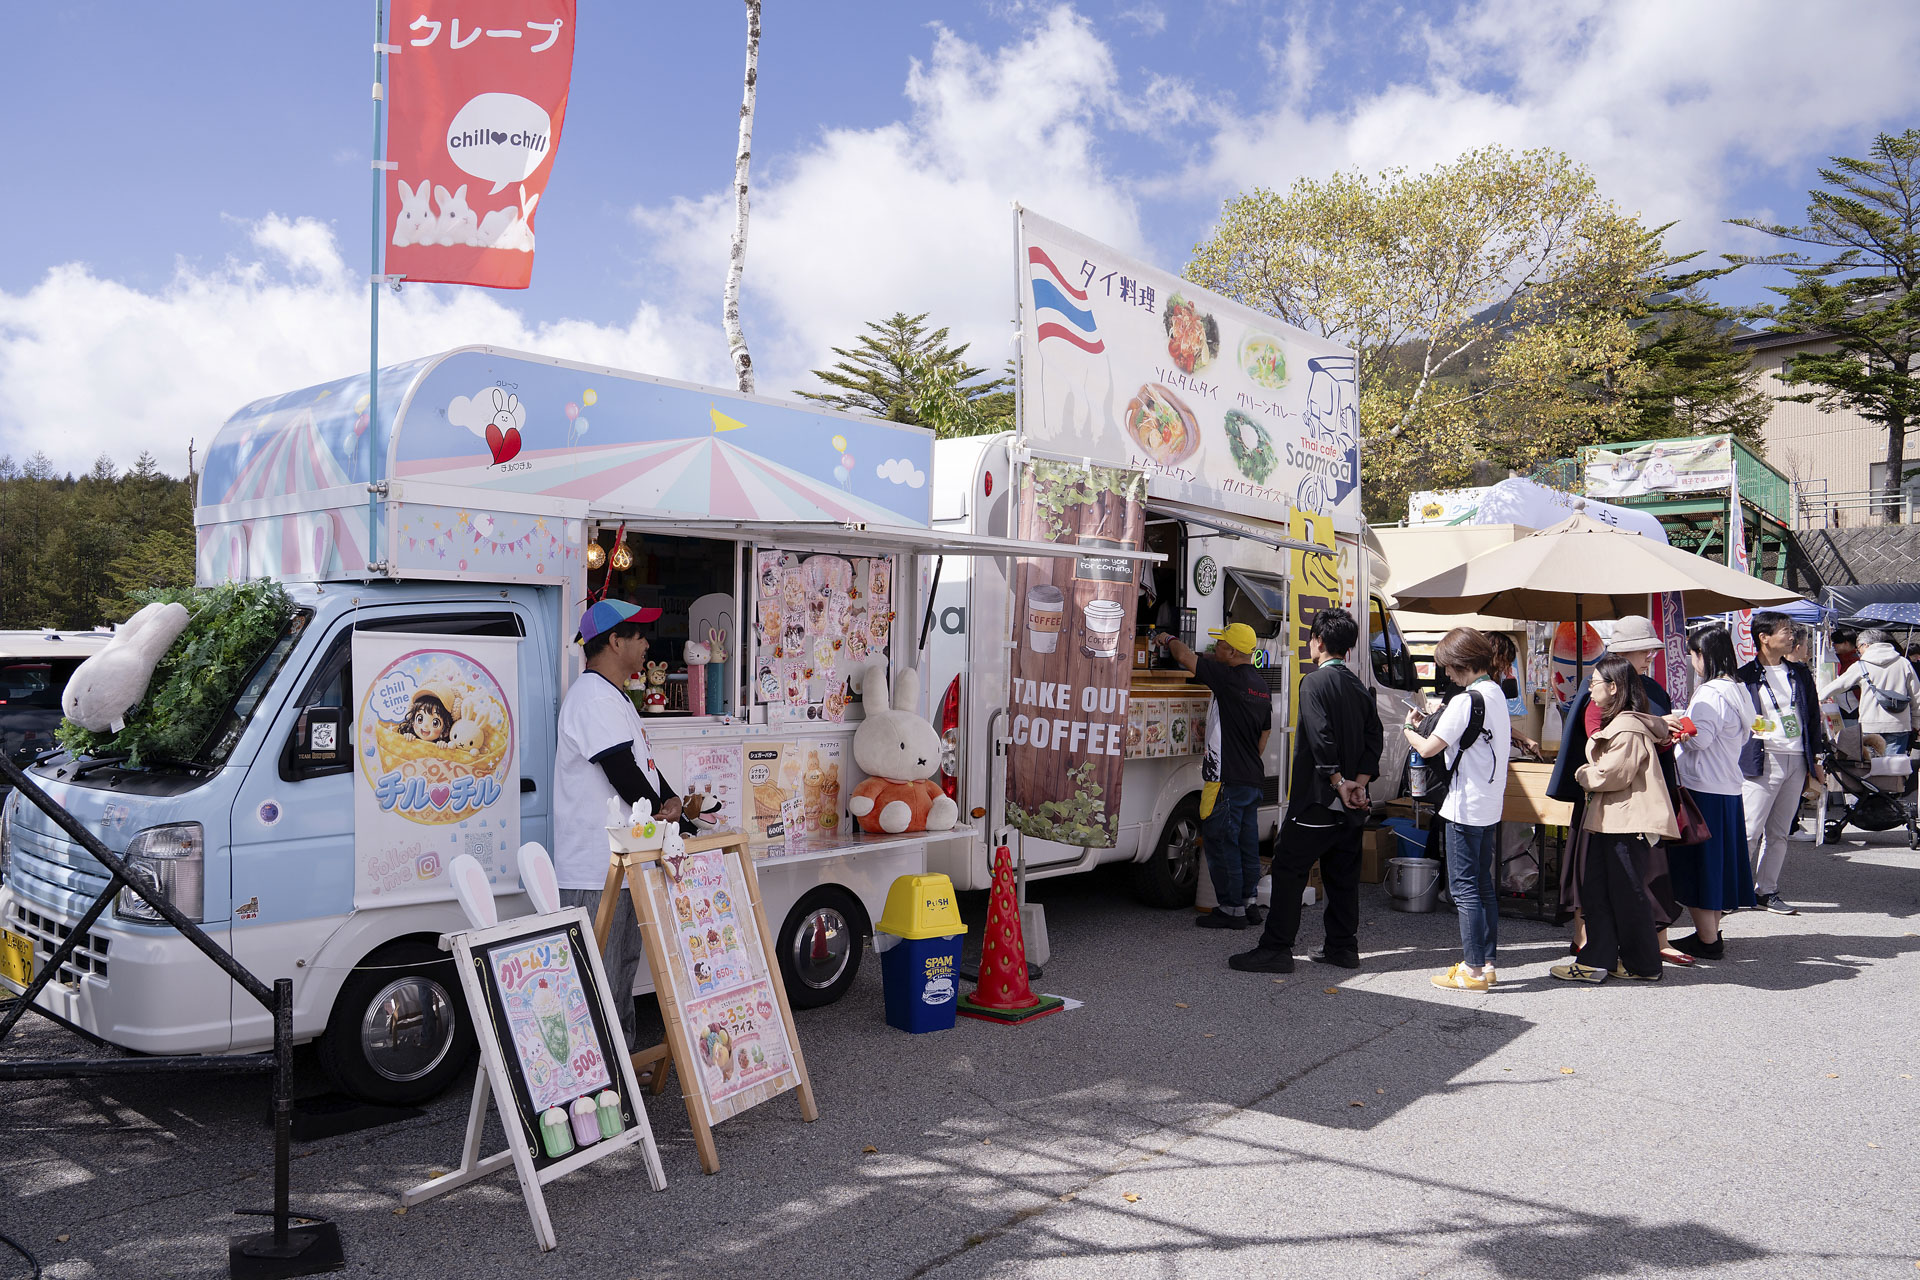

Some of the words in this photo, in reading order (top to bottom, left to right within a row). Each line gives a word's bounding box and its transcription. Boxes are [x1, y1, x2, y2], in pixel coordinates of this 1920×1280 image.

[409, 14, 564, 53] クレープ
[450, 128, 490, 149] chill
[510, 130, 547, 152] chill
[1080, 259, 1156, 314] タイ料理
[1155, 366, 1219, 401] ソムタムタイ
[1300, 436, 1319, 452] Thai
[1320, 445, 1337, 458] cafe
[1029, 613, 1062, 626] COFFEE
[1087, 635, 1116, 645] COFFEE
[379, 681, 405, 698] chill
[382, 692, 410, 709] time
[1013, 677, 1071, 711] TAKE
[1081, 686, 1130, 716] OUT
[1012, 714, 1121, 757] COFFEE
[697, 754, 730, 766] DRINK
[376, 771, 430, 812] チル
[450, 775, 502, 812] チル
[368, 841, 422, 882] follow
[383, 865, 412, 892] me
[501, 945, 569, 990] クリームソーダ
[925, 955, 953, 969] SPAM
[718, 1001, 755, 1027] ころころ
[732, 1020, 754, 1036] アイス
